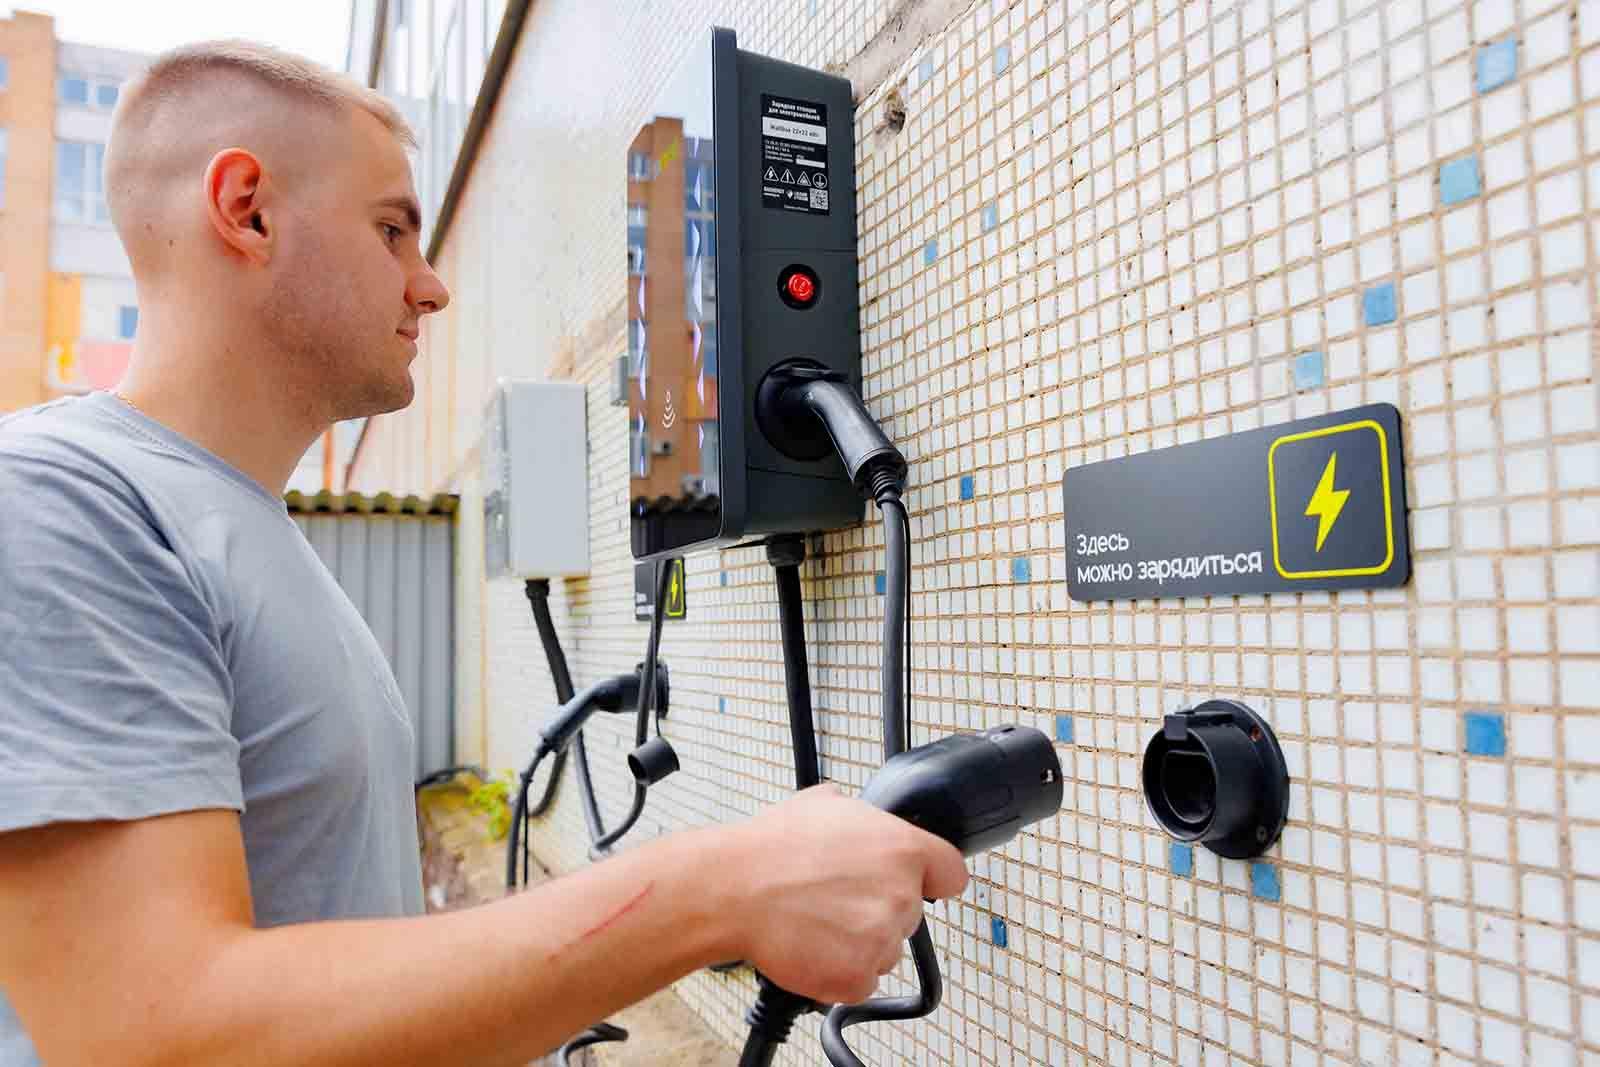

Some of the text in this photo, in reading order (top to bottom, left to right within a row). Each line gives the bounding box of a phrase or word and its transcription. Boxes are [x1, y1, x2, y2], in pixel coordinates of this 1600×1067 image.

[1076, 533, 1129, 556] Здесь
[1077, 551, 1263, 584] можно зарядиться
